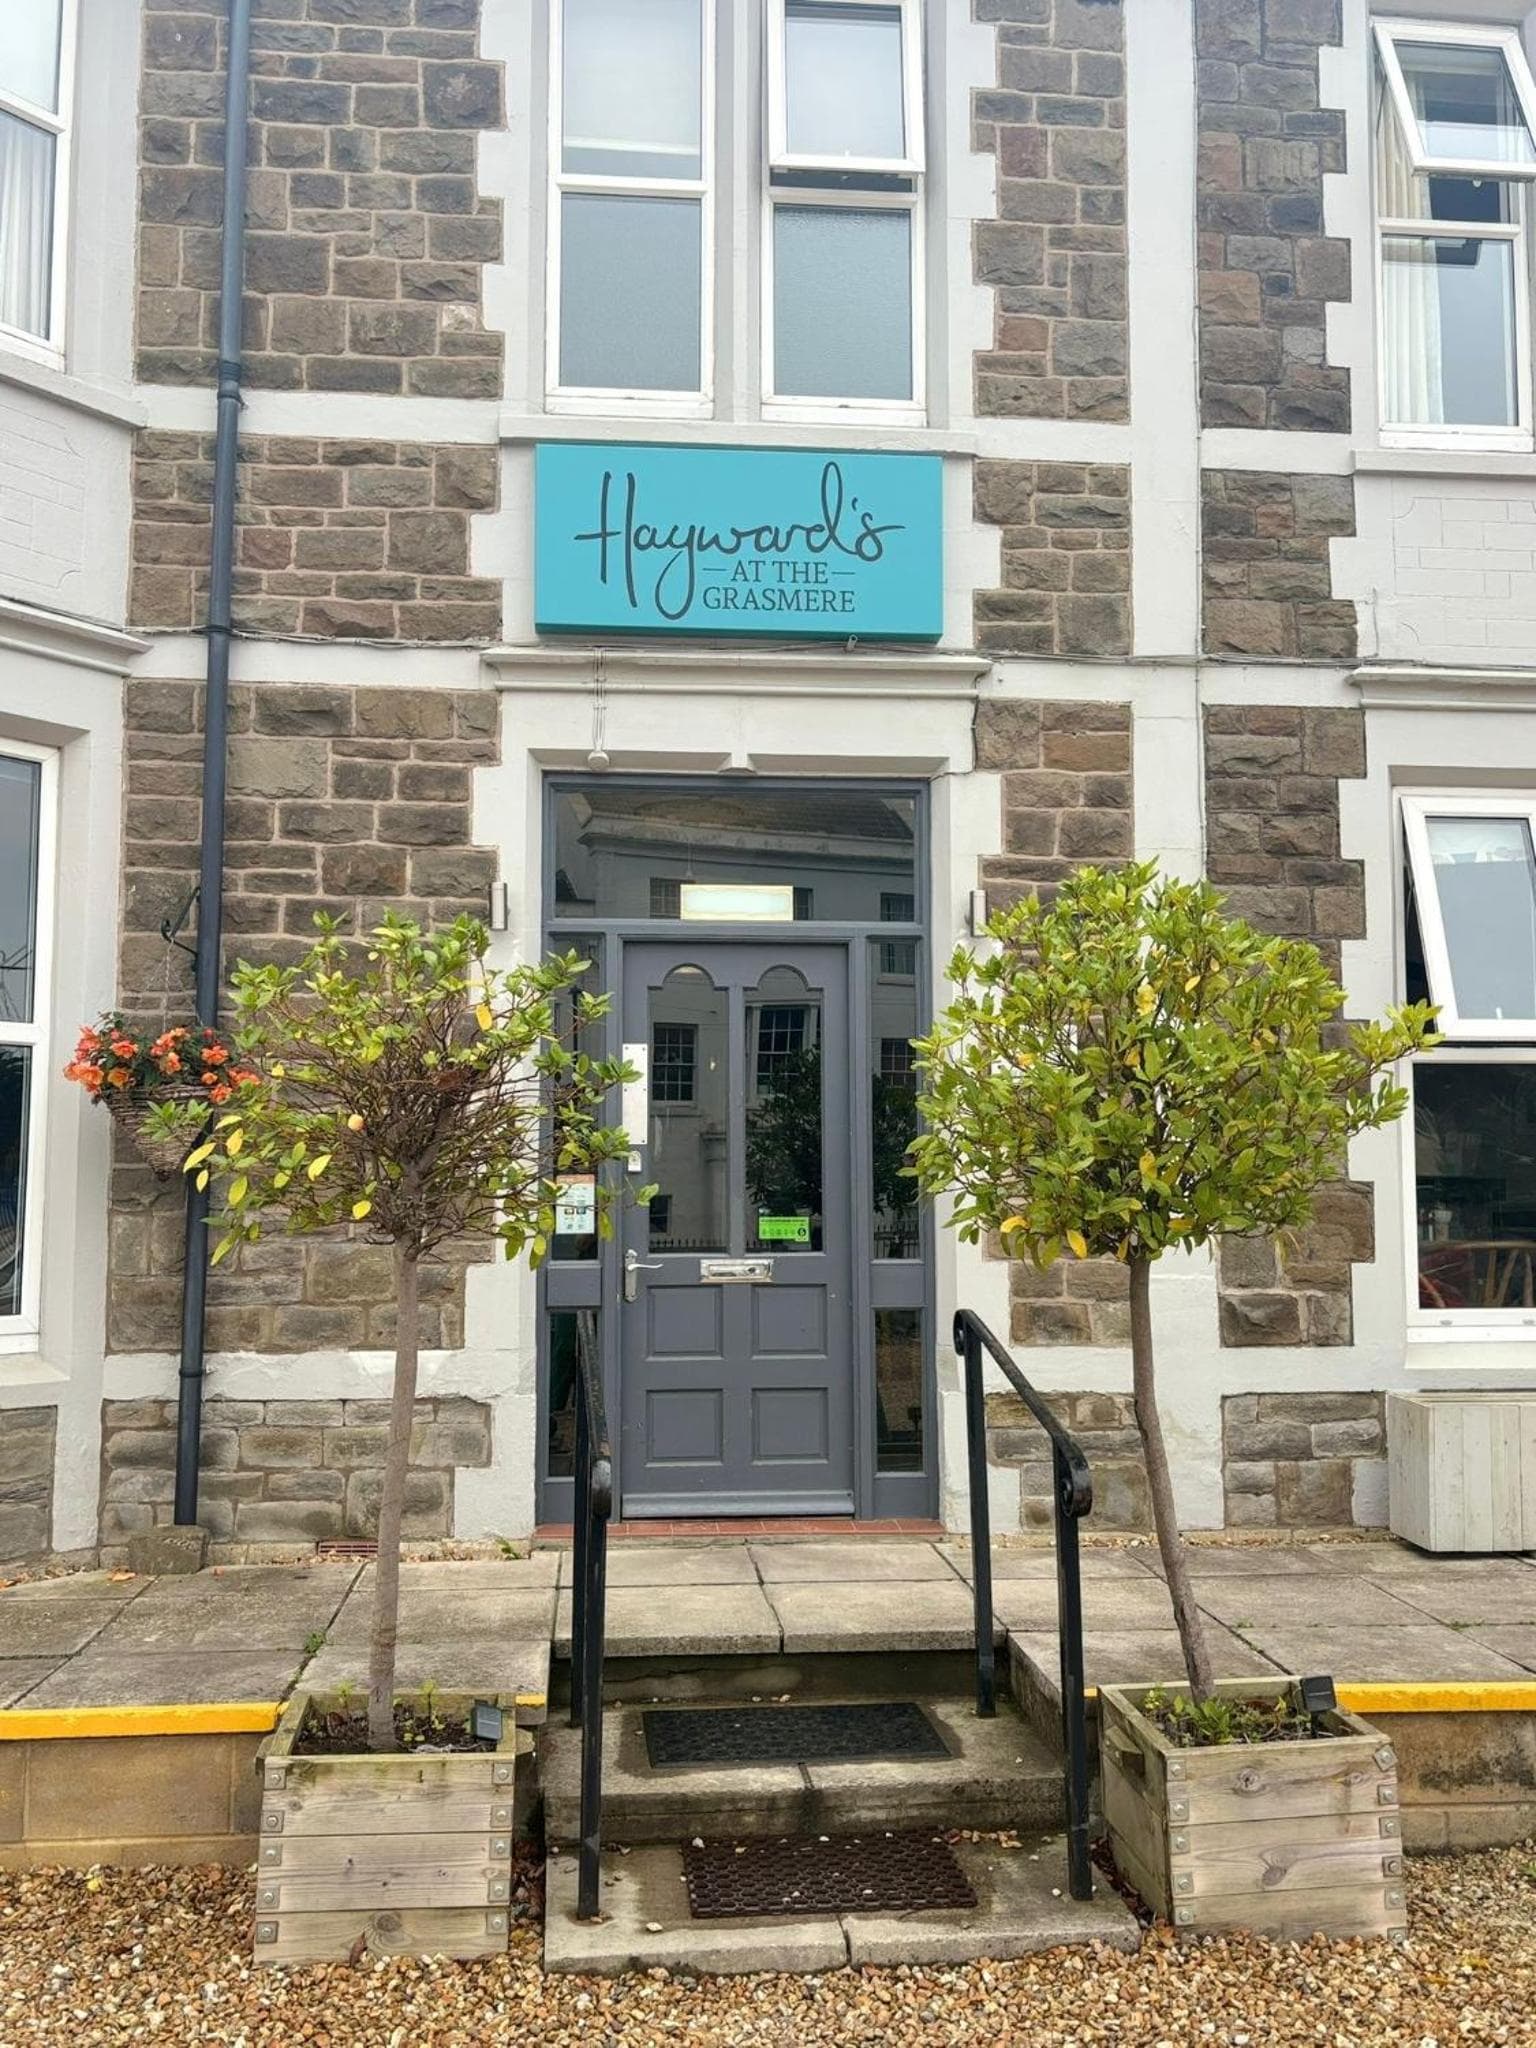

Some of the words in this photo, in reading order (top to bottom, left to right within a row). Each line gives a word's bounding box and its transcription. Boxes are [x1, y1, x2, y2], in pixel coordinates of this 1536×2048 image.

[574, 460, 906, 621] Hayward's
[730, 559, 766, 583] AT
[772, 560, 829, 585] THE
[702, 586, 856, 613] GRASMERE
